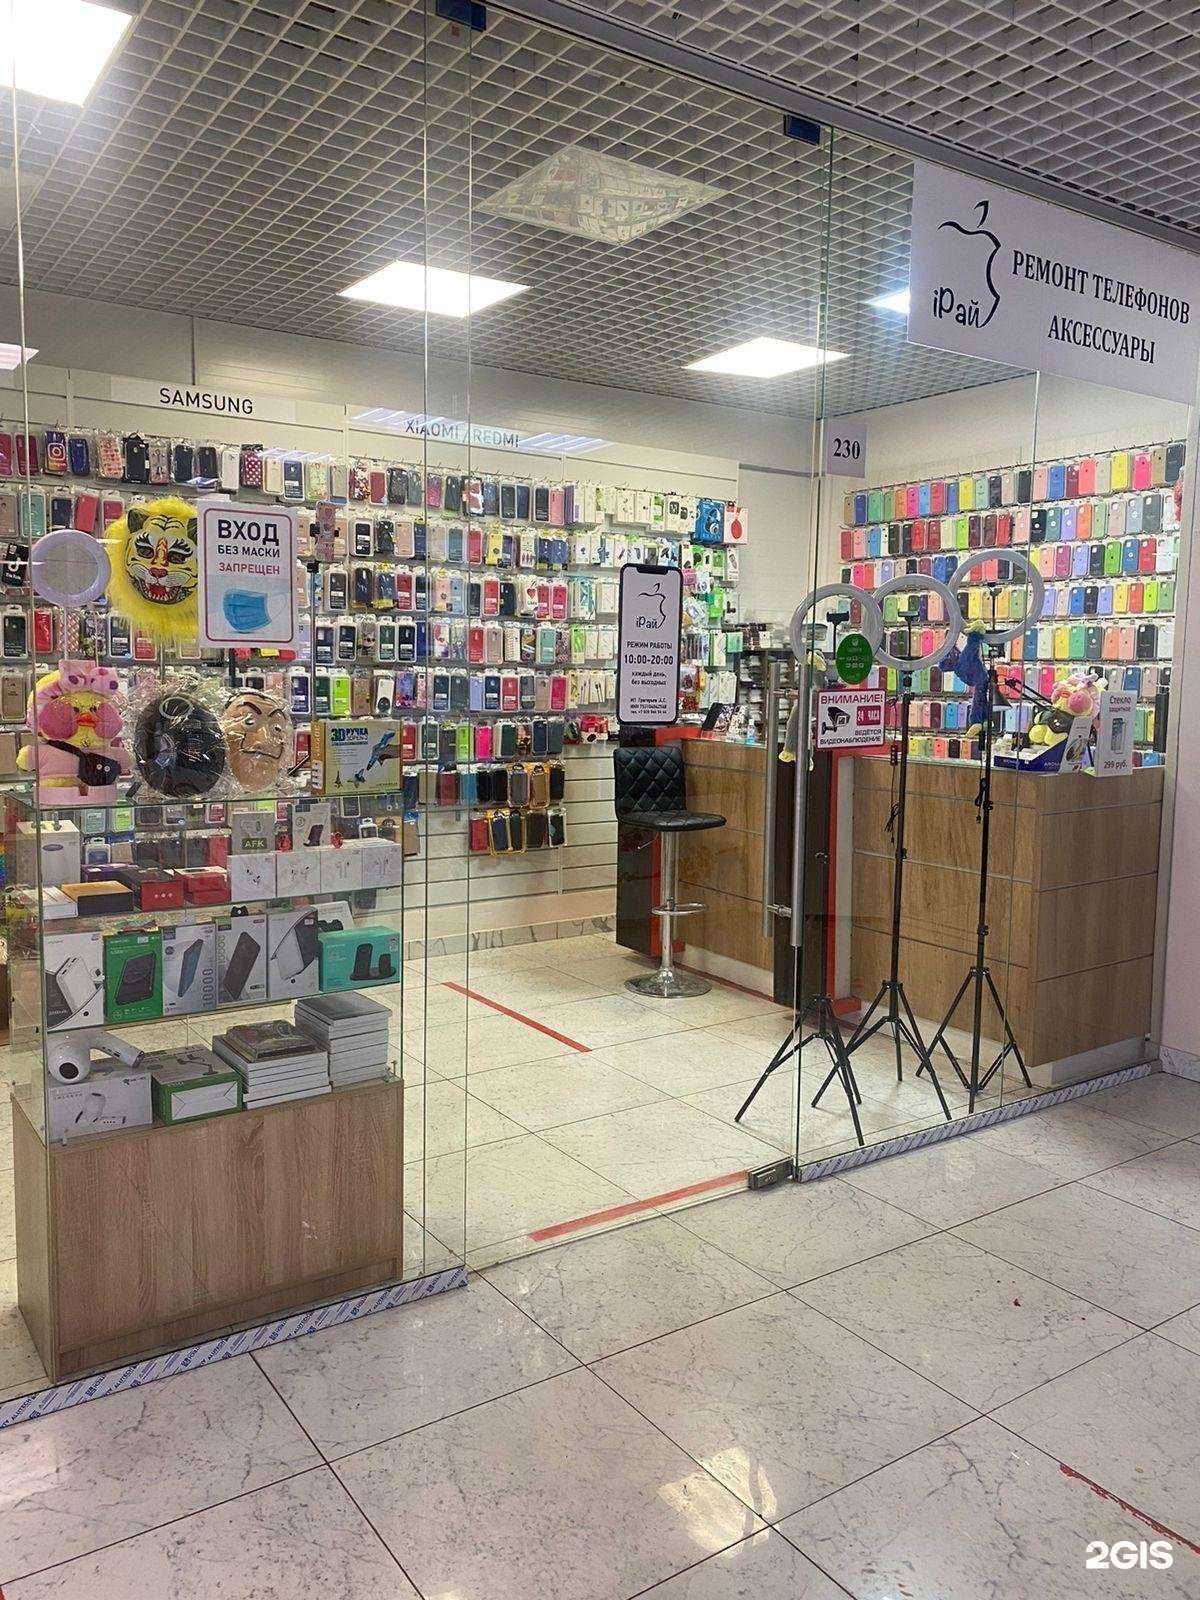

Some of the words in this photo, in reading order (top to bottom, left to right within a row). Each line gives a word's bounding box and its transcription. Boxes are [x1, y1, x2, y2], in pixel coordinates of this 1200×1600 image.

[1012, 249, 1089, 295] РЕМОНТ
[1092, 274, 1190, 325] ТЕЛЕФОНОВ
[1047, 315, 1155, 364] АКСЕССУАРЫ
[159, 387, 253, 415] SAMSUNG
[833, 437, 861, 460] 230
[217, 519, 280, 546] ВХОД
[217, 545, 239, 555] БЕЗ
[242, 546, 280, 558] МАСКИ
[218, 562, 280, 575] ЗАПРЕЩЕН
[626, 641, 648, 649] РЕЖИМ
[649, 642, 673, 650] РАБОТЫ
[624, 654, 674, 665] 10:00-20:00
[820, 693, 883, 705] ВНИМАНИЕ!
[819, 735, 881, 745] ВИДЕОНАБЛЮДЕНИЕ
[243, 840, 264, 848] AFK
